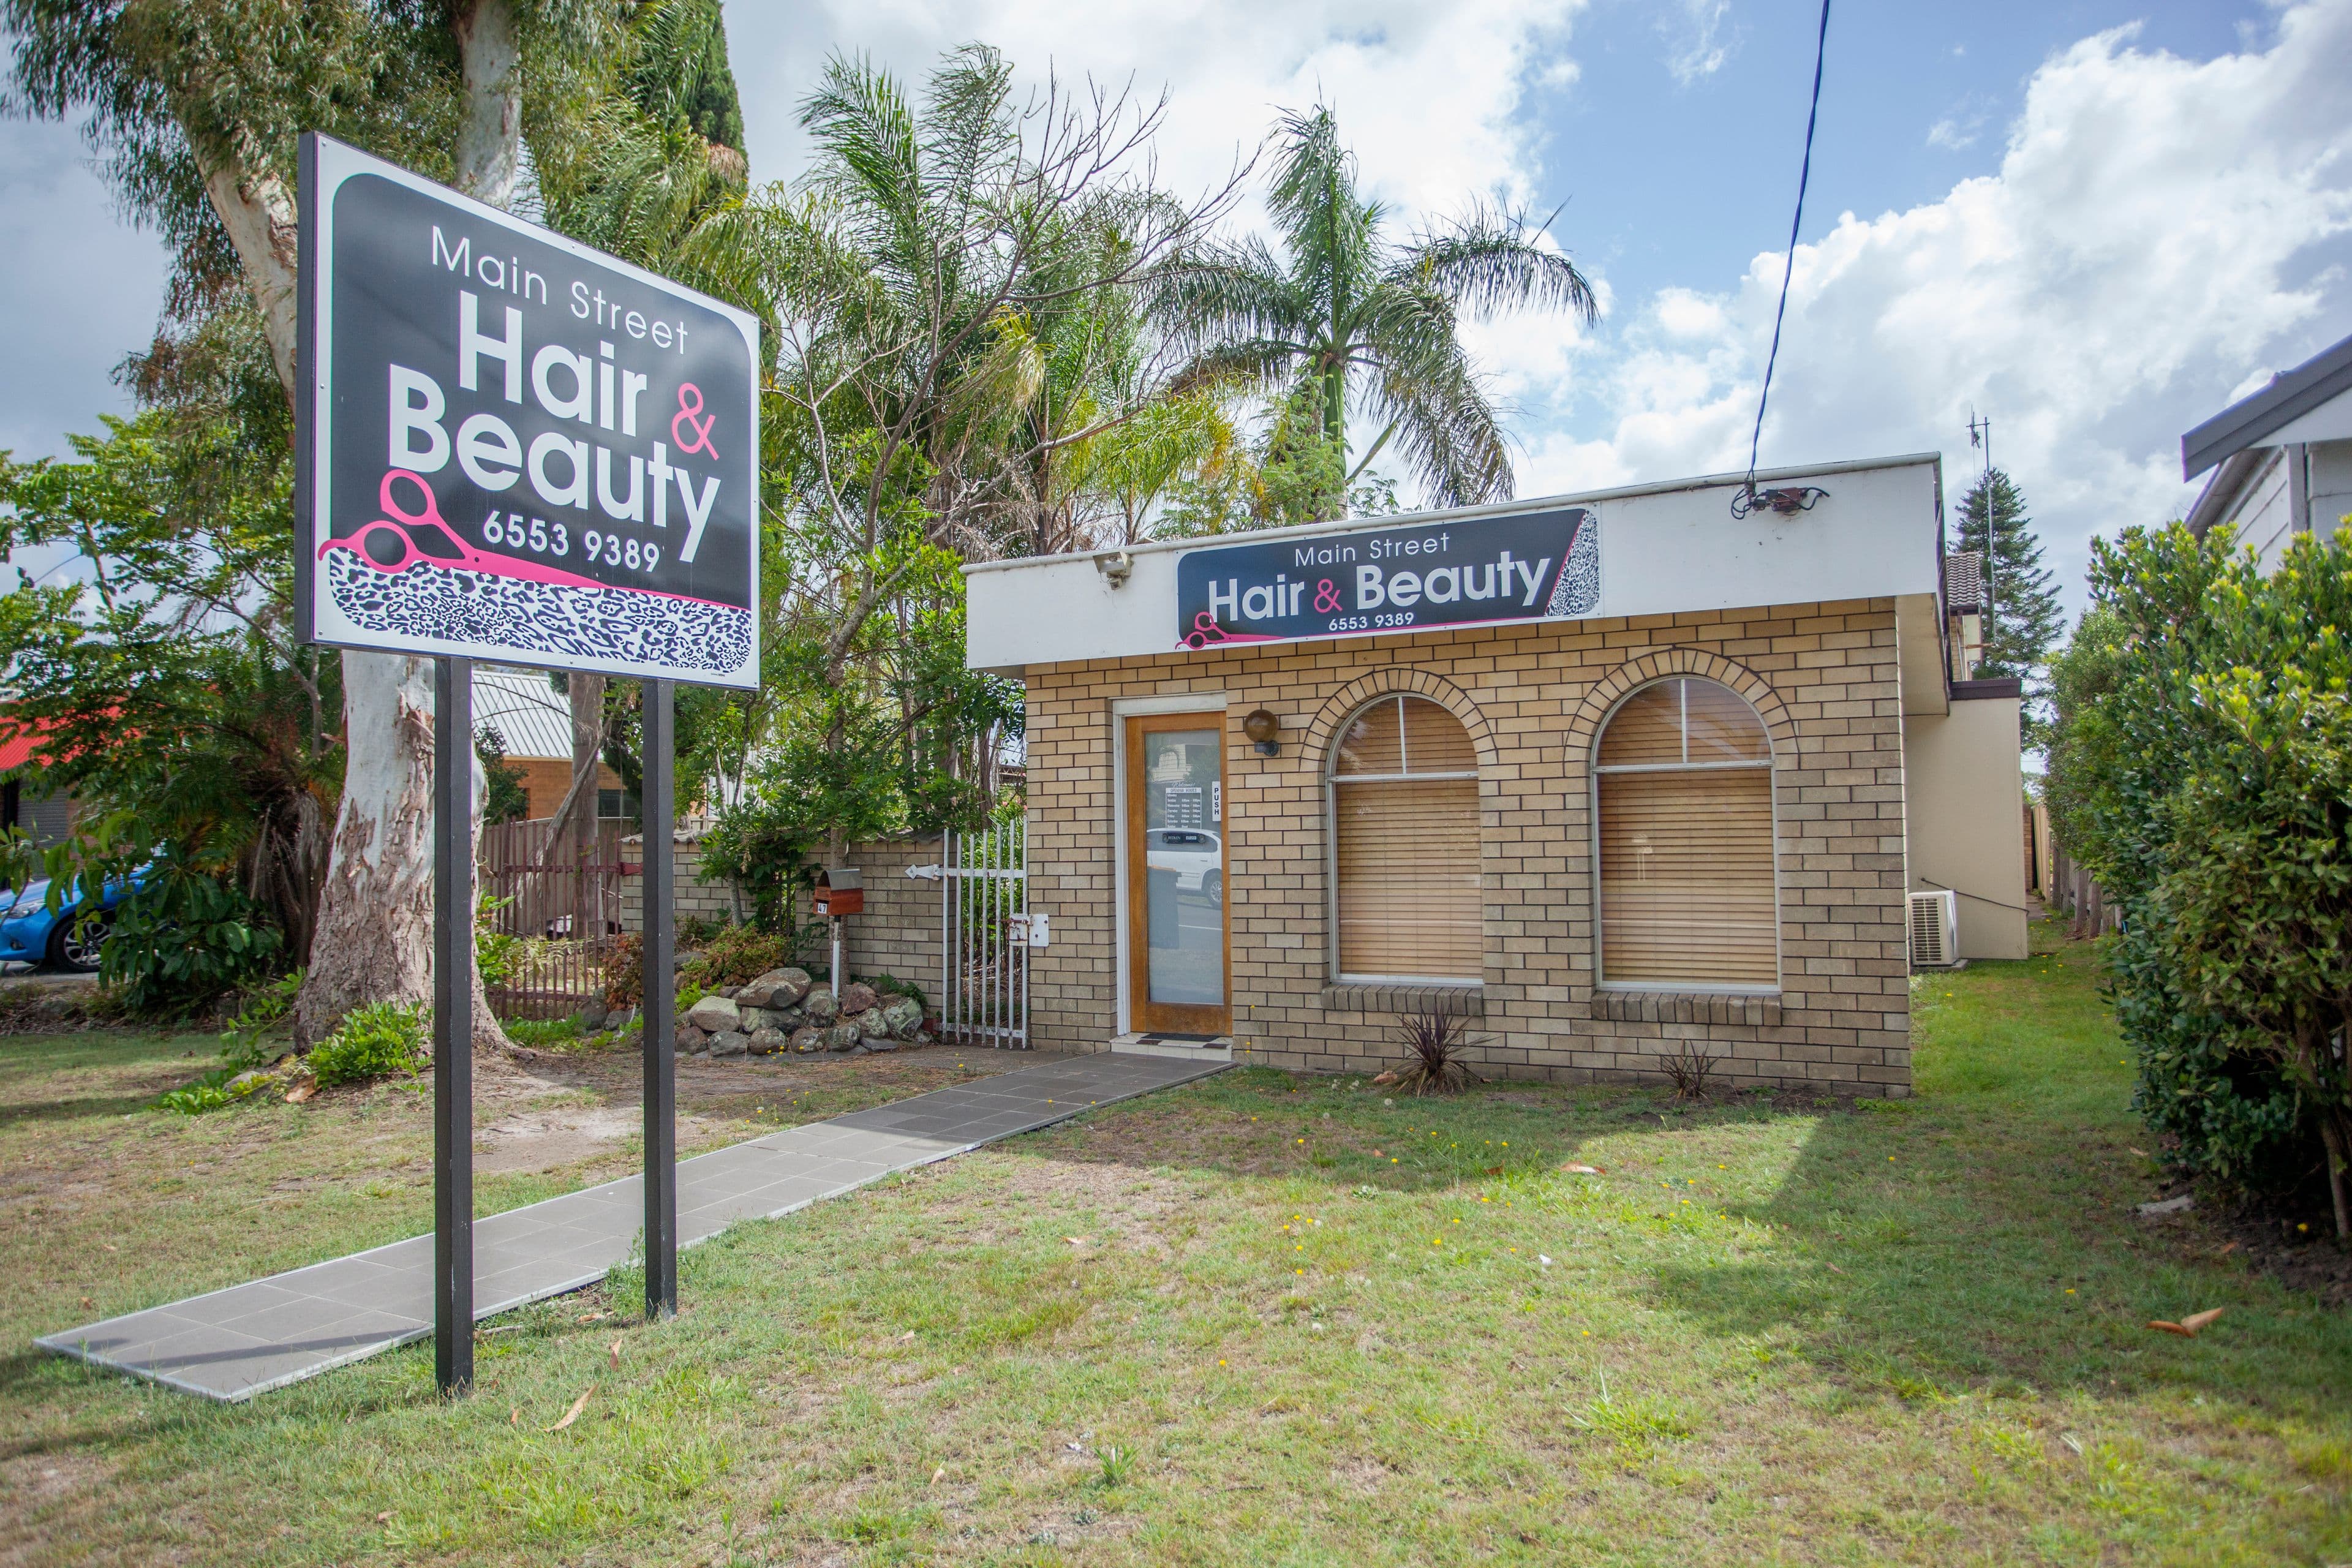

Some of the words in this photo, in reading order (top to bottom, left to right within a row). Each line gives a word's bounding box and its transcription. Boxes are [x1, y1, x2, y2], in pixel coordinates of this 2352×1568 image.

[431, 225, 548, 304] Main
[570, 281, 688, 355] Street
[459, 290, 647, 437] Hair
[671, 382, 719, 460] &
[389, 364, 720, 563] Beauty
[483, 511, 568, 556] 6553
[584, 530, 660, 572] 9389
[1295, 547, 1356, 567] Main
[1370, 532, 1450, 559] Street
[1208, 574, 1305, 623] Hair
[1314, 579, 1343, 613] &
[1356, 551, 1551, 609] Beauty
[1329, 616, 1368, 631] 6553
[1374, 612, 1414, 627] 9389
[818, 904, 826, 913] 47
